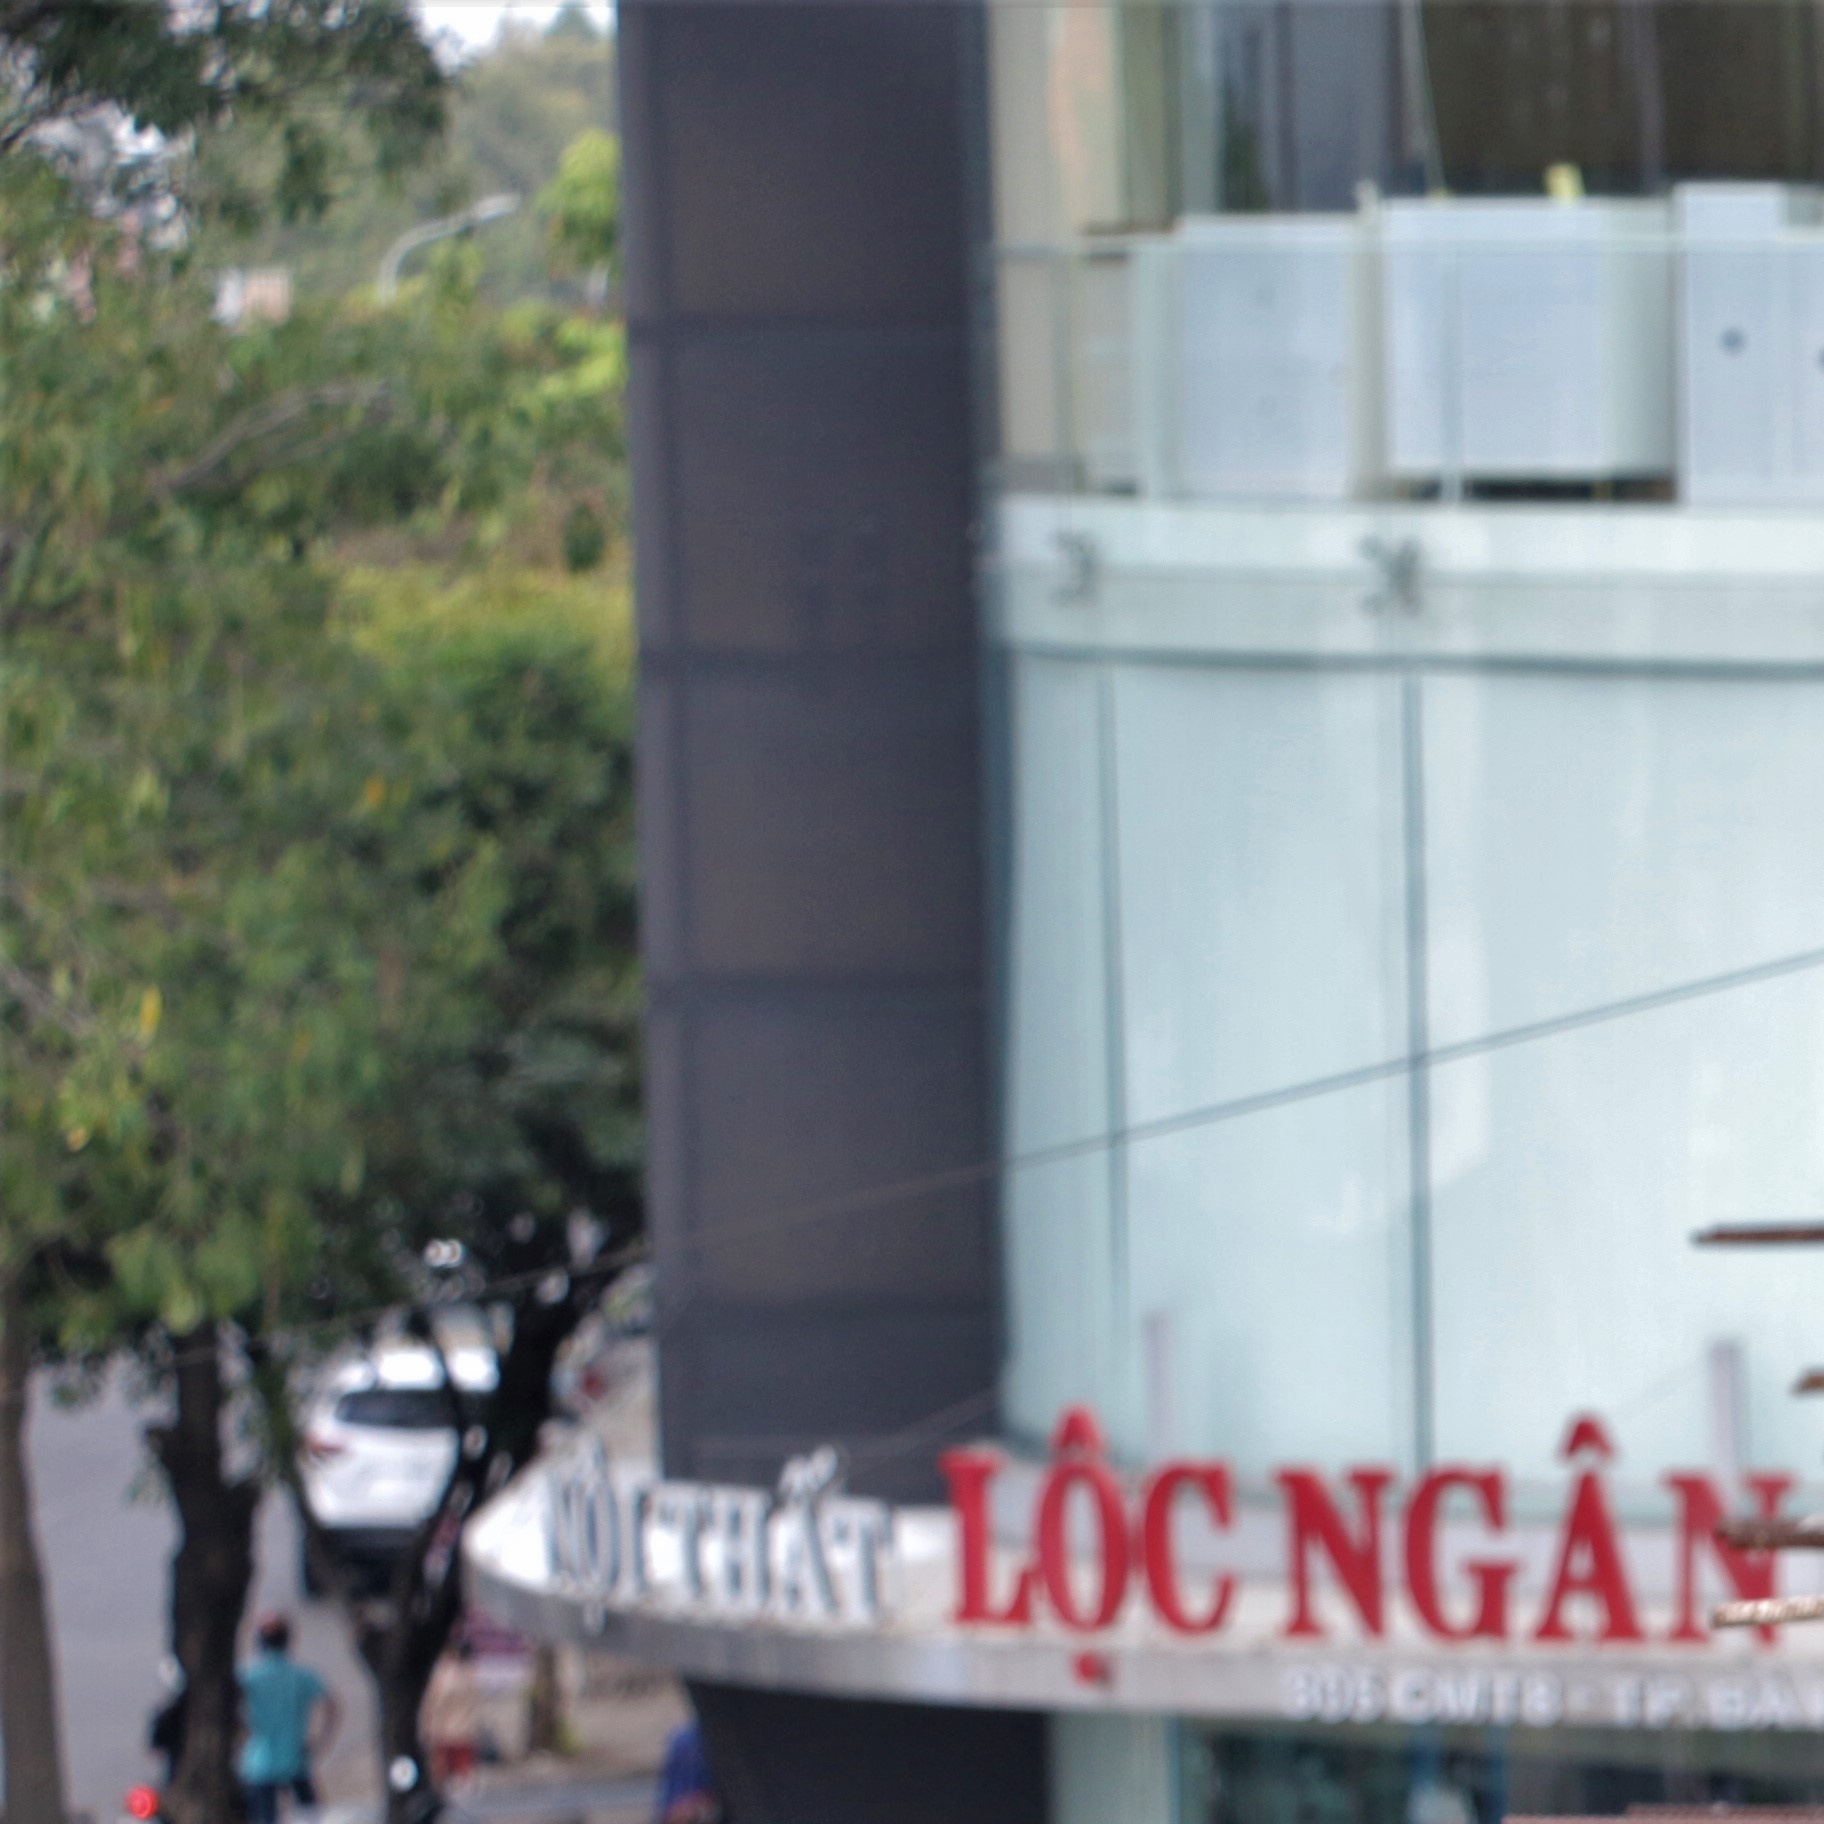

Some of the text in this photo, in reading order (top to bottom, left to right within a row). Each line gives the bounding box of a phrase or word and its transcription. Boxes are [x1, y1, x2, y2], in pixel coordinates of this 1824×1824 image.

[543, 1404, 1796, 1686] NỘI THẤT LỘC NGÂN
